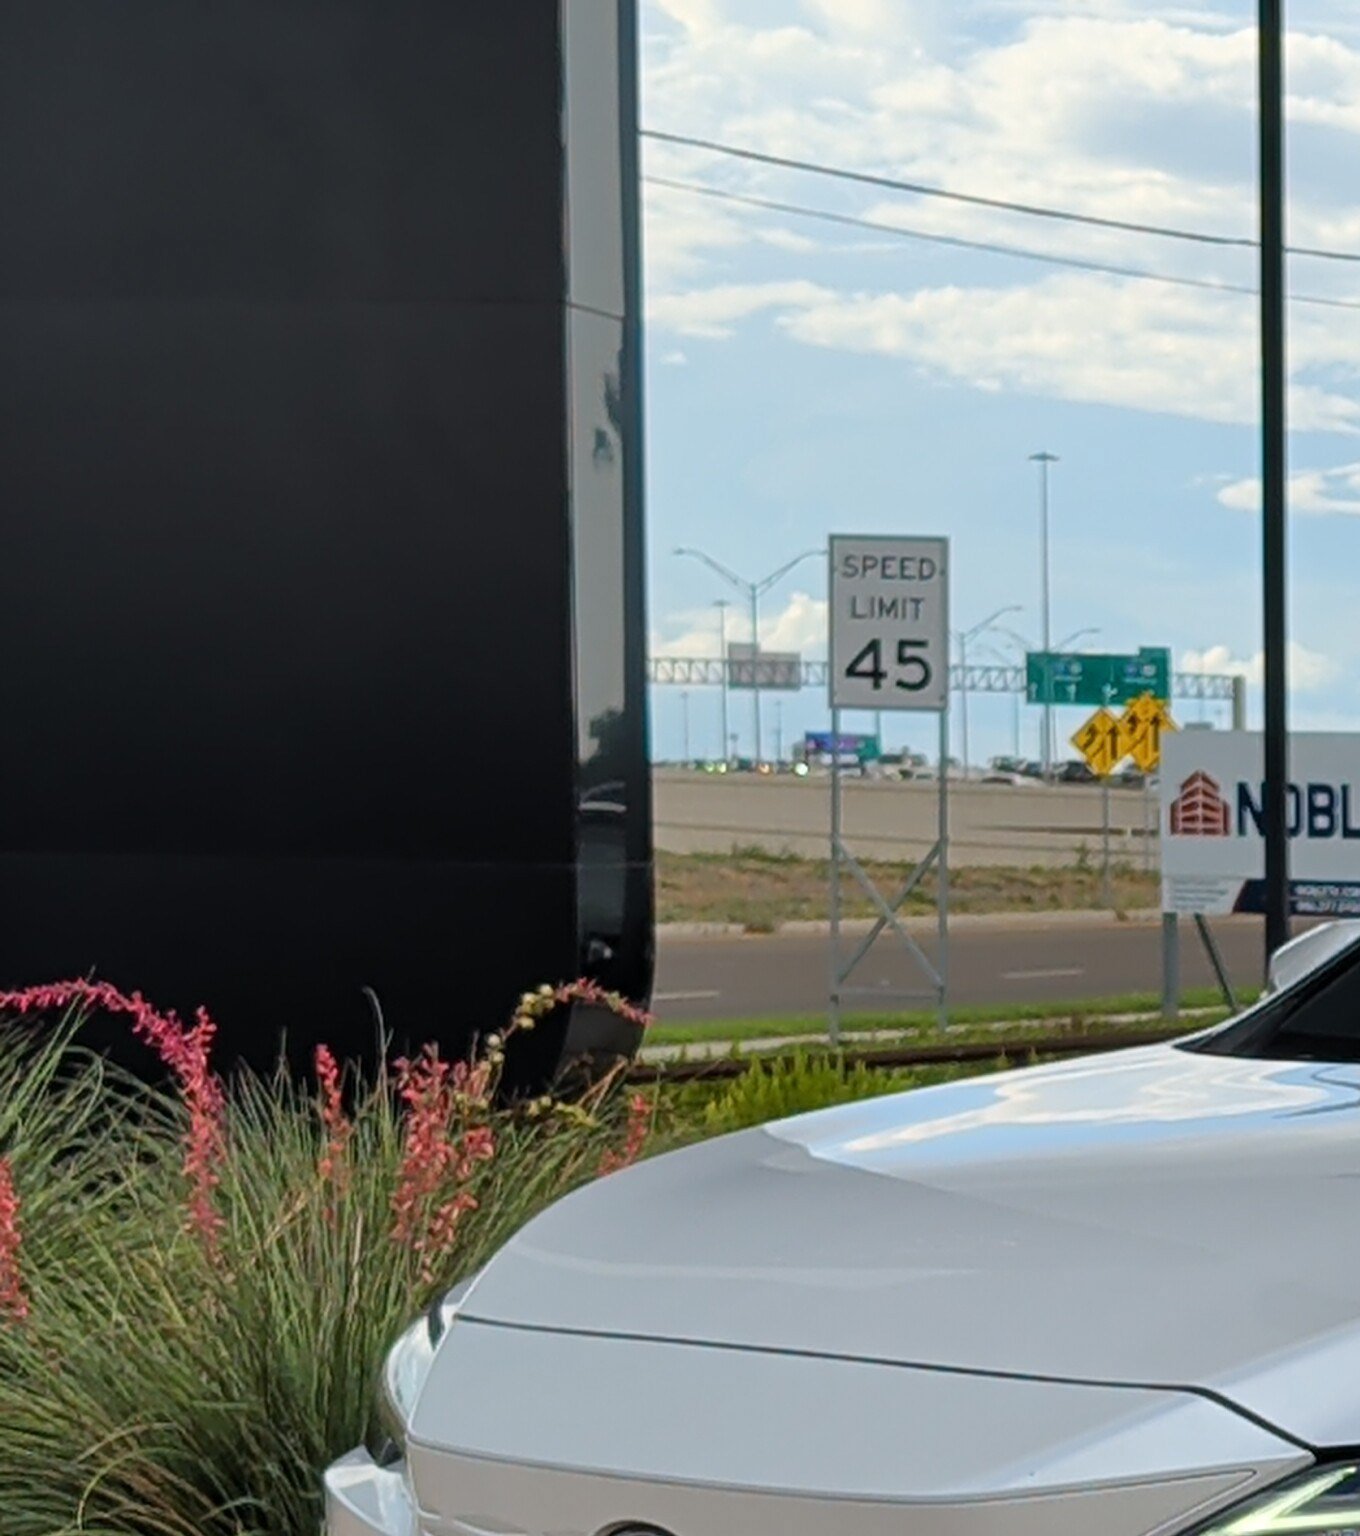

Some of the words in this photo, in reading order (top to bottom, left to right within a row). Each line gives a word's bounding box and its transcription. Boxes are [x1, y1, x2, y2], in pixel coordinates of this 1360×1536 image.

[842, 555, 937, 581] SPEED
[850, 596, 924, 621] LIMIT
[845, 638, 932, 691] 45
